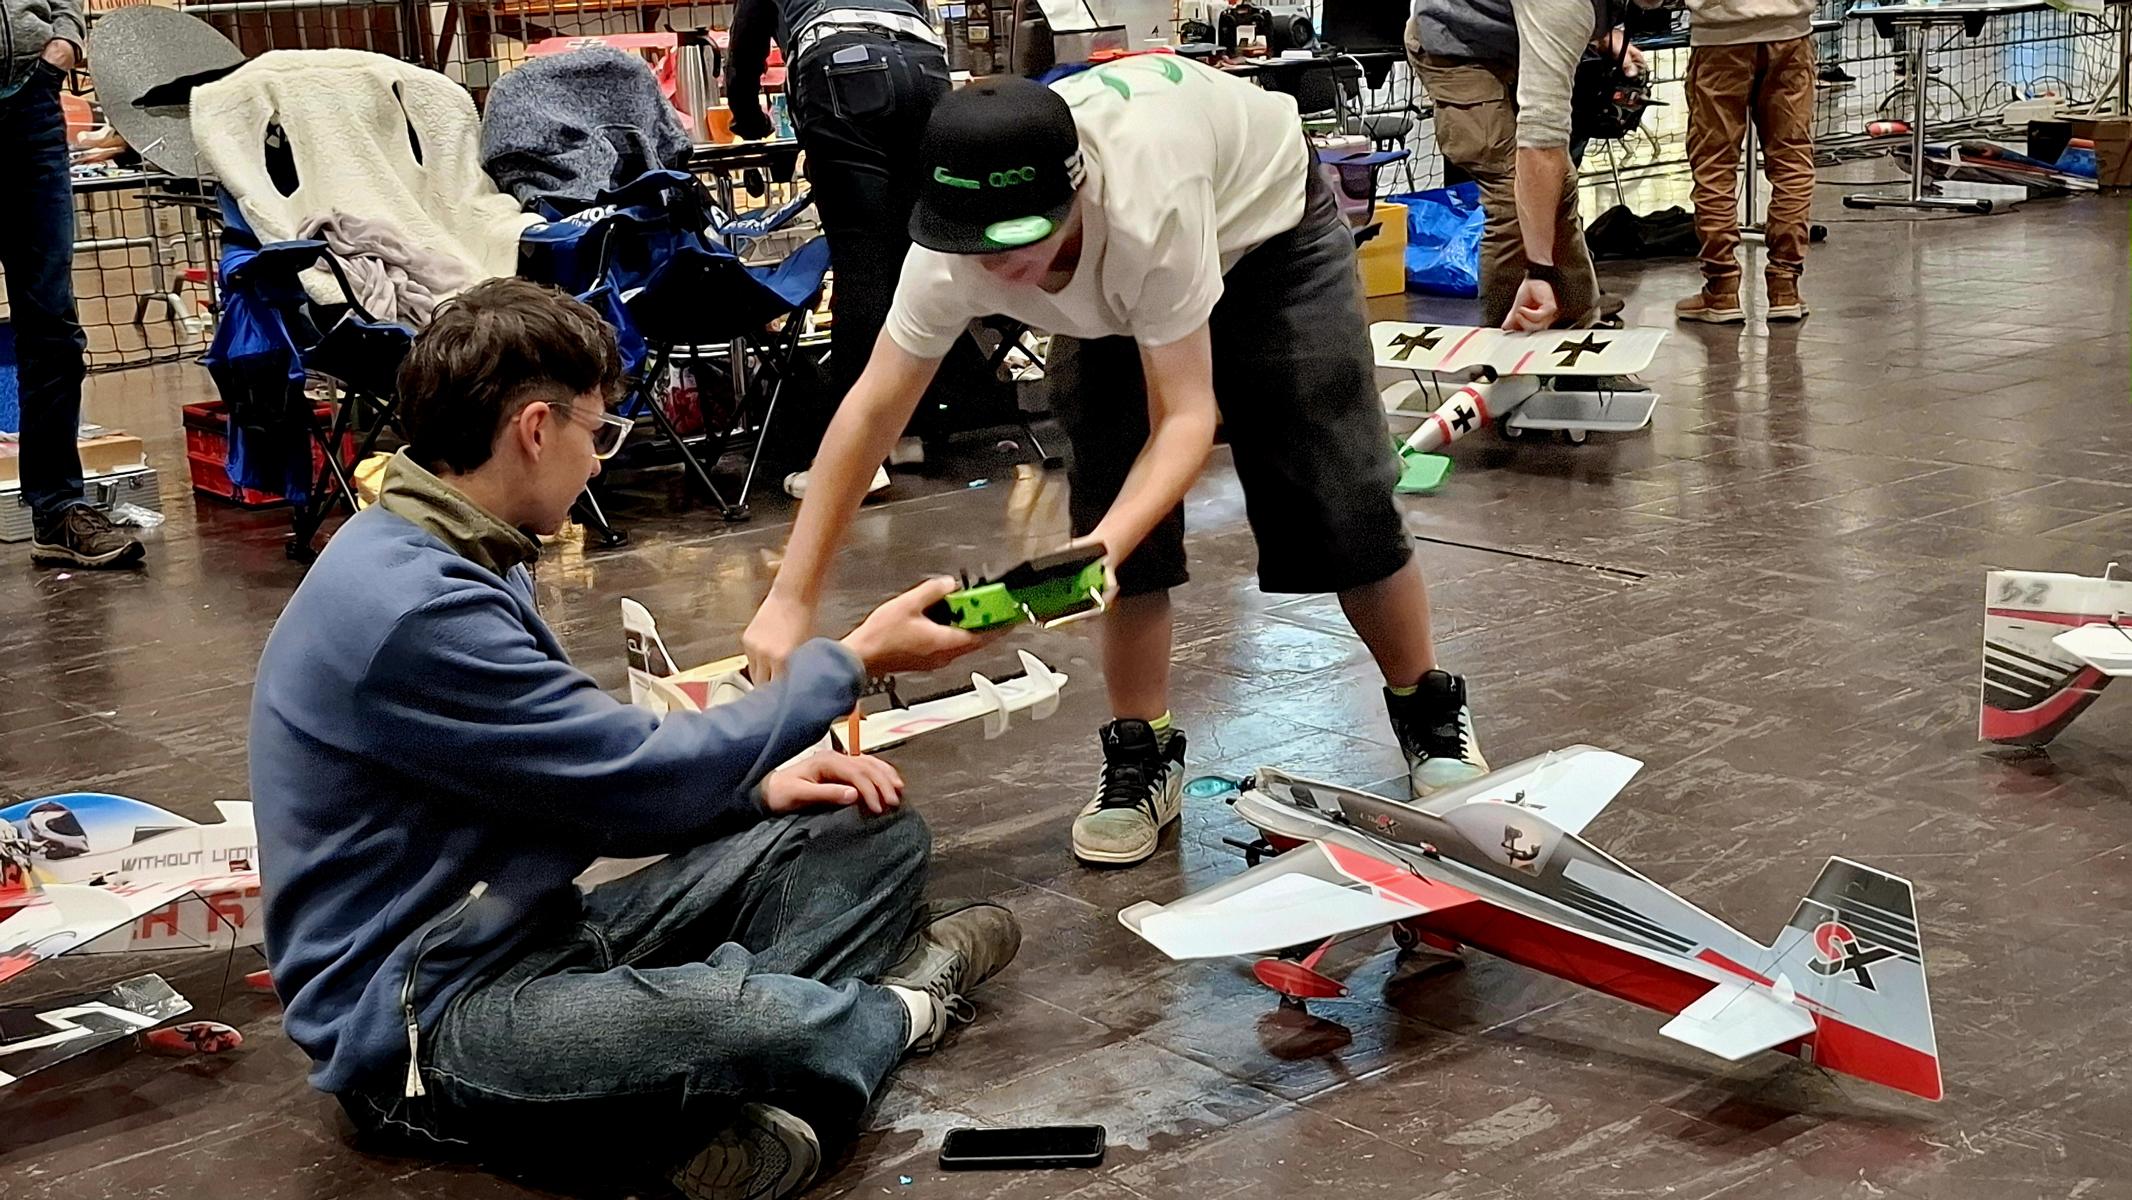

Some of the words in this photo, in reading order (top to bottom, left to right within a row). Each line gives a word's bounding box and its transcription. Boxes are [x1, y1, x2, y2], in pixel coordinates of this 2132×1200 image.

[121, 850, 203, 872] WITHOUT
[212, 845, 259, 863] LIMI
[1806, 921, 1904, 994] SX
